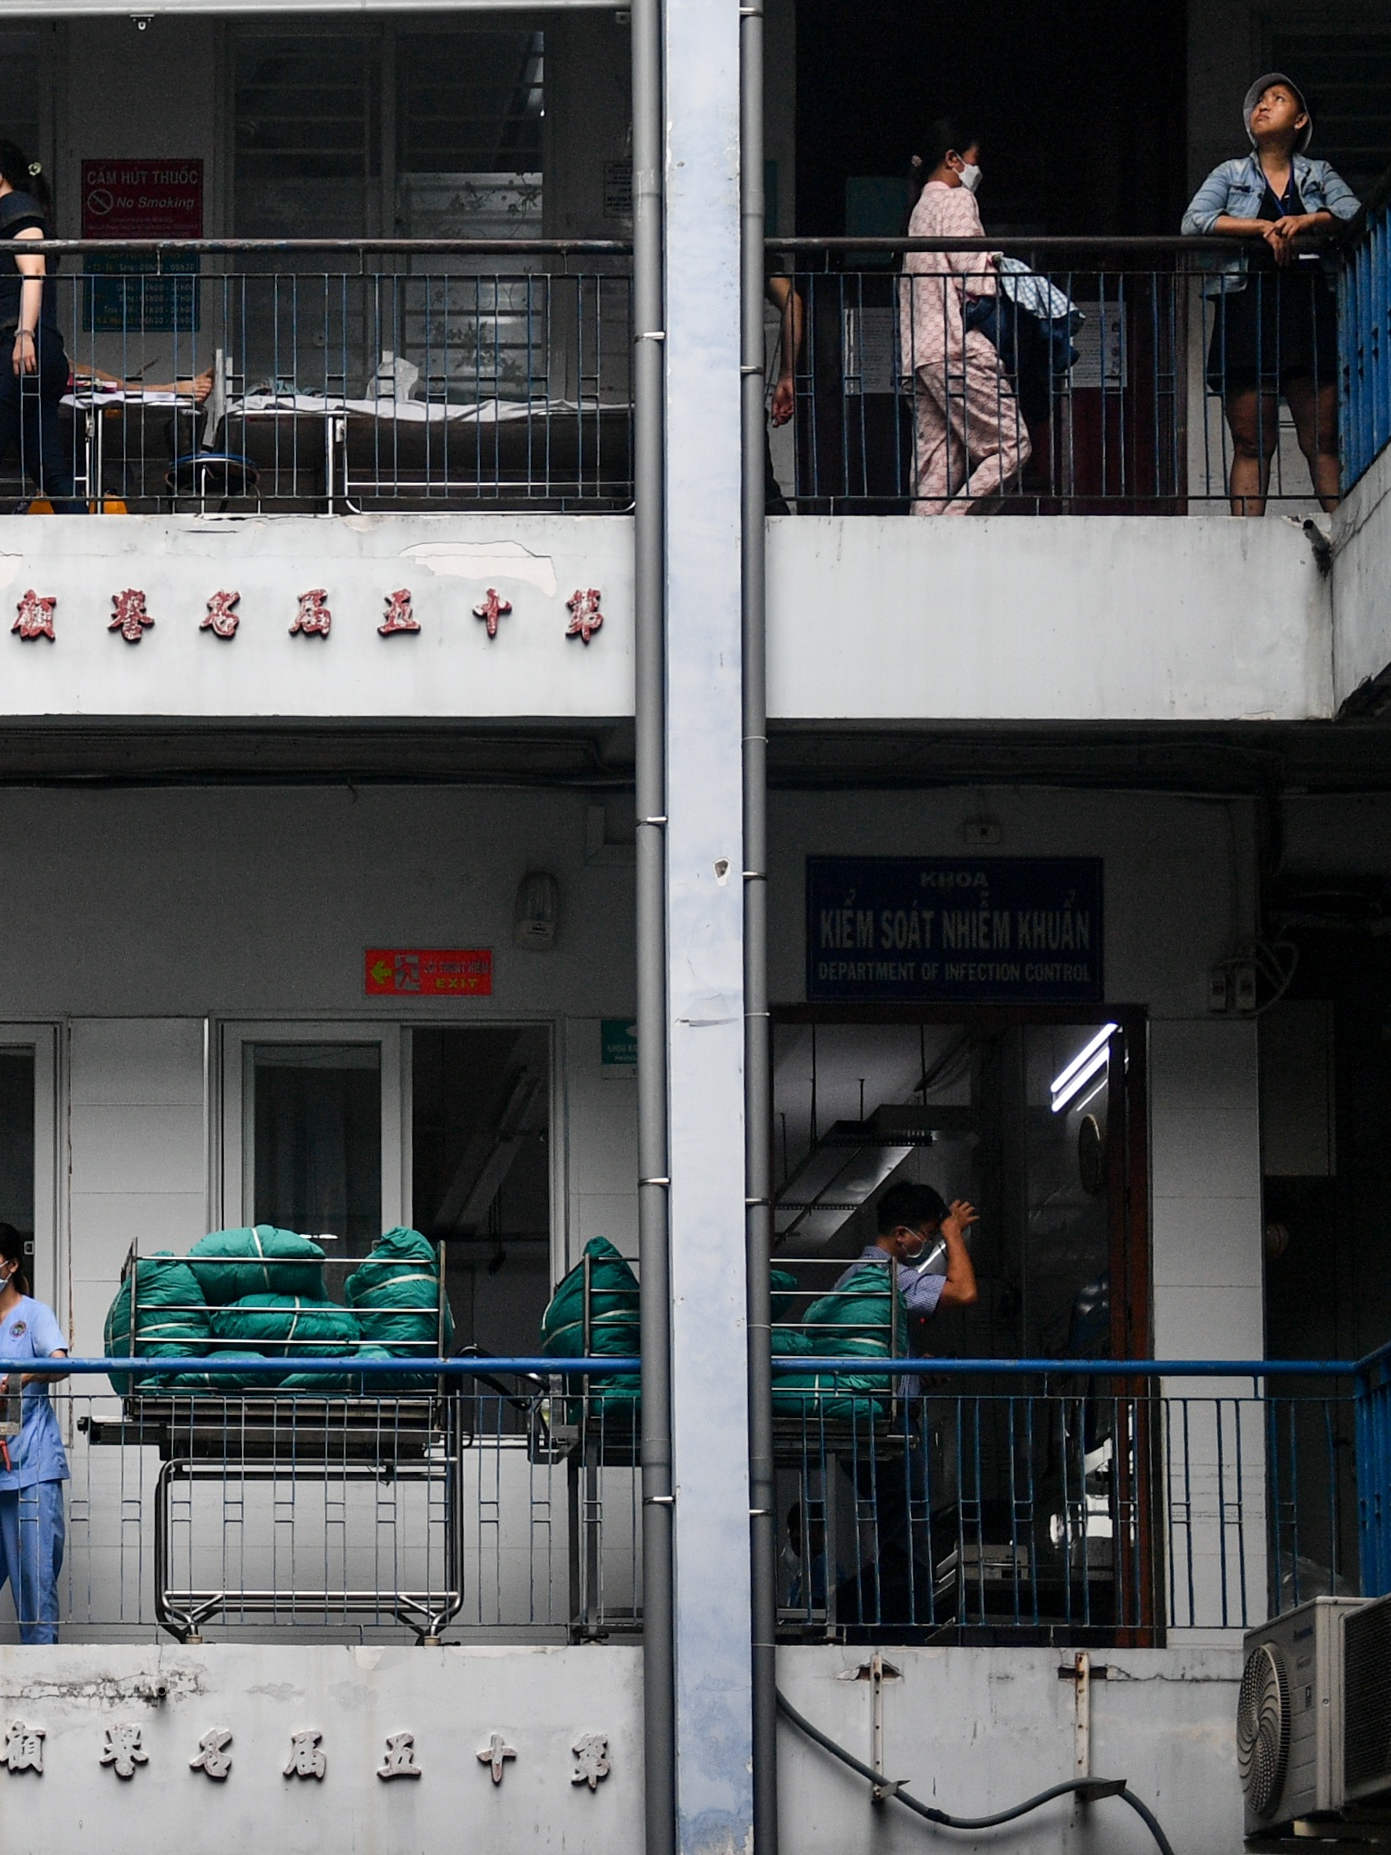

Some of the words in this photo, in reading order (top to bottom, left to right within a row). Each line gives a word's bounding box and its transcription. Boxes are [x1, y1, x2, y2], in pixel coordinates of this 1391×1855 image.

[87, 166, 117, 185] CẤM
[121, 167, 149, 184] HÚT
[152, 165, 199, 184] THUỐC
[116, 197, 134, 209] No
[138, 196, 195, 211] Smoking
[920, 871, 989, 888] KHOA
[820, 888, 874, 949] KIỂM
[881, 900, 935, 949] SOÁT
[942, 891, 1010, 949] NHIỄM
[1017, 889, 1090, 950] KHUẨN
[818, 961, 916, 981] DEPARTMENT
[921, 962, 939, 981] OF
[945, 962, 1020, 981] INFECTION
[1025, 962, 1091, 982] CONTROL
[435, 978, 478, 988] EXIT
